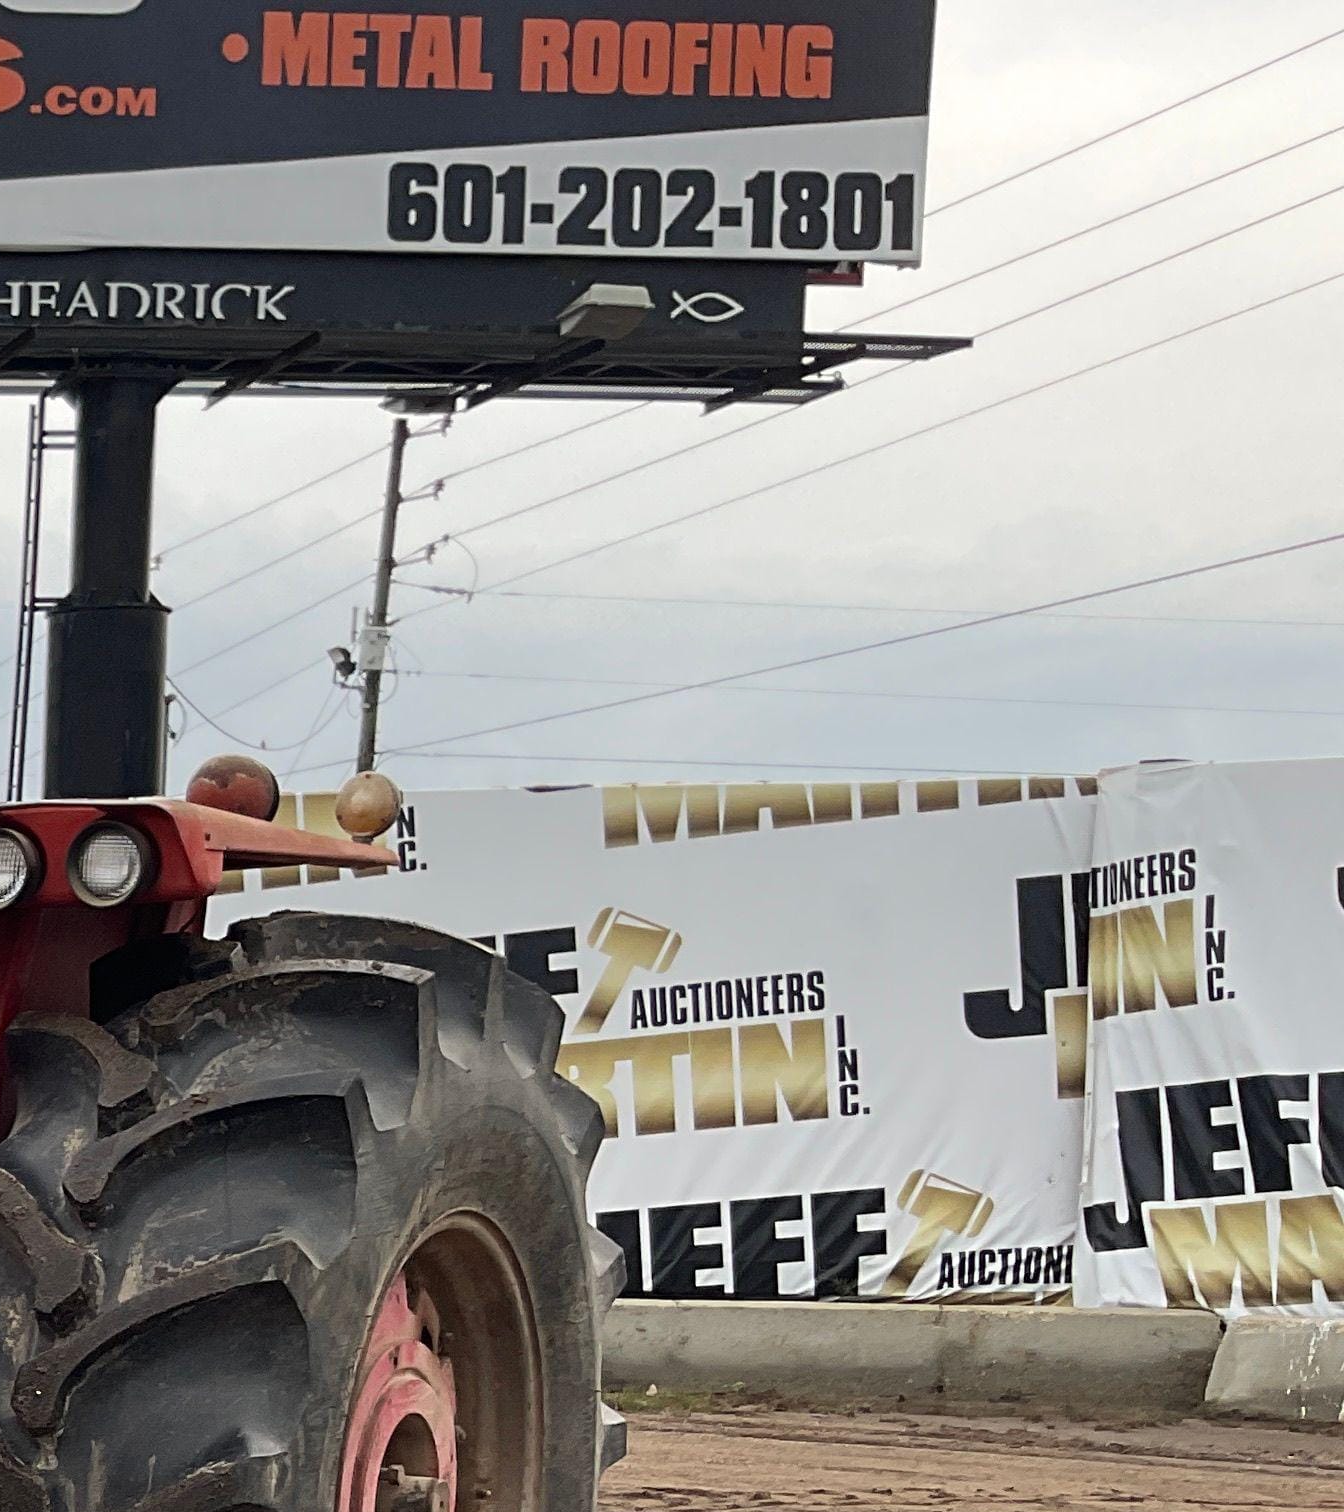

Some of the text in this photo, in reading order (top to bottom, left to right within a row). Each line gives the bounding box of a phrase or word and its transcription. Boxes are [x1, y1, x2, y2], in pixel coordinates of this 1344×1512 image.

[261, 11, 833, 99] METAL ROOFING
[387, 161, 916, 252] 601-202-1801
[397, 804, 428, 872] NC.
[1090, 849, 1197, 909] TIONEERS
[630, 970, 826, 1030] AUCTIONEERS
[937, 1244, 1074, 1291] AUCTION
